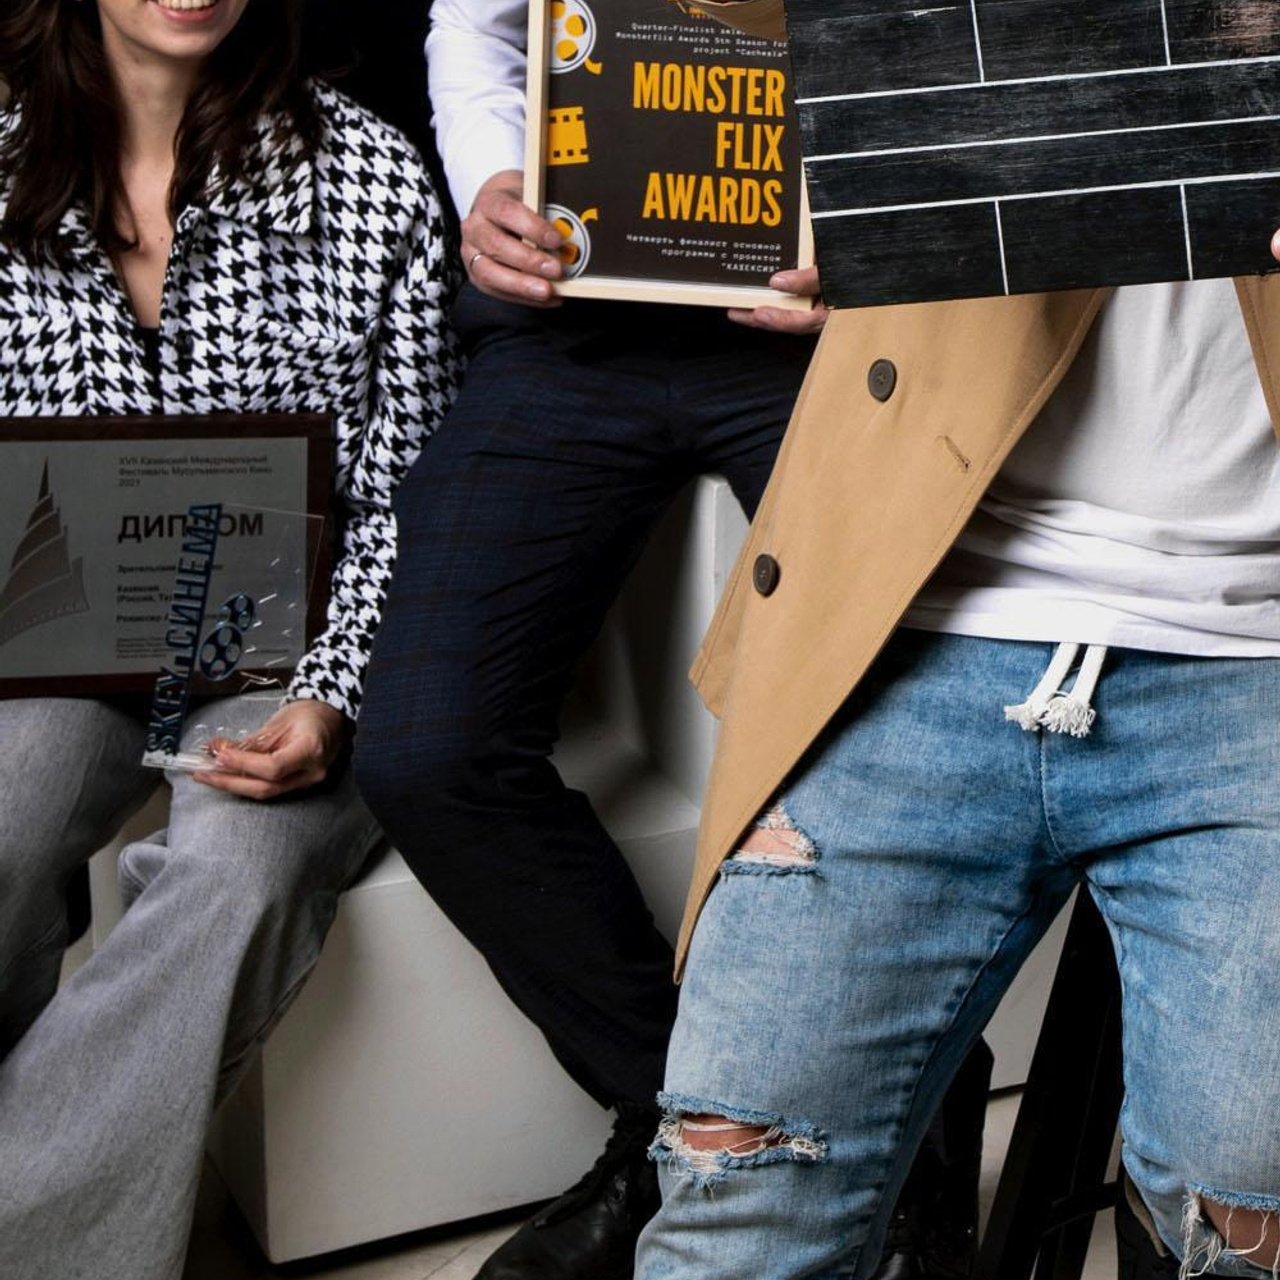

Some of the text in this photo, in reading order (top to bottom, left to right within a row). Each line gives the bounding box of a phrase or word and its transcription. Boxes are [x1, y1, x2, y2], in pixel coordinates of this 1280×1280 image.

[693, 46, 731, 56] project
[773, 40, 788, 48] for
[633, 62, 785, 117] MONSTER
[716, 122, 784, 172] FLIX
[641, 171, 783, 227] AWARDS
